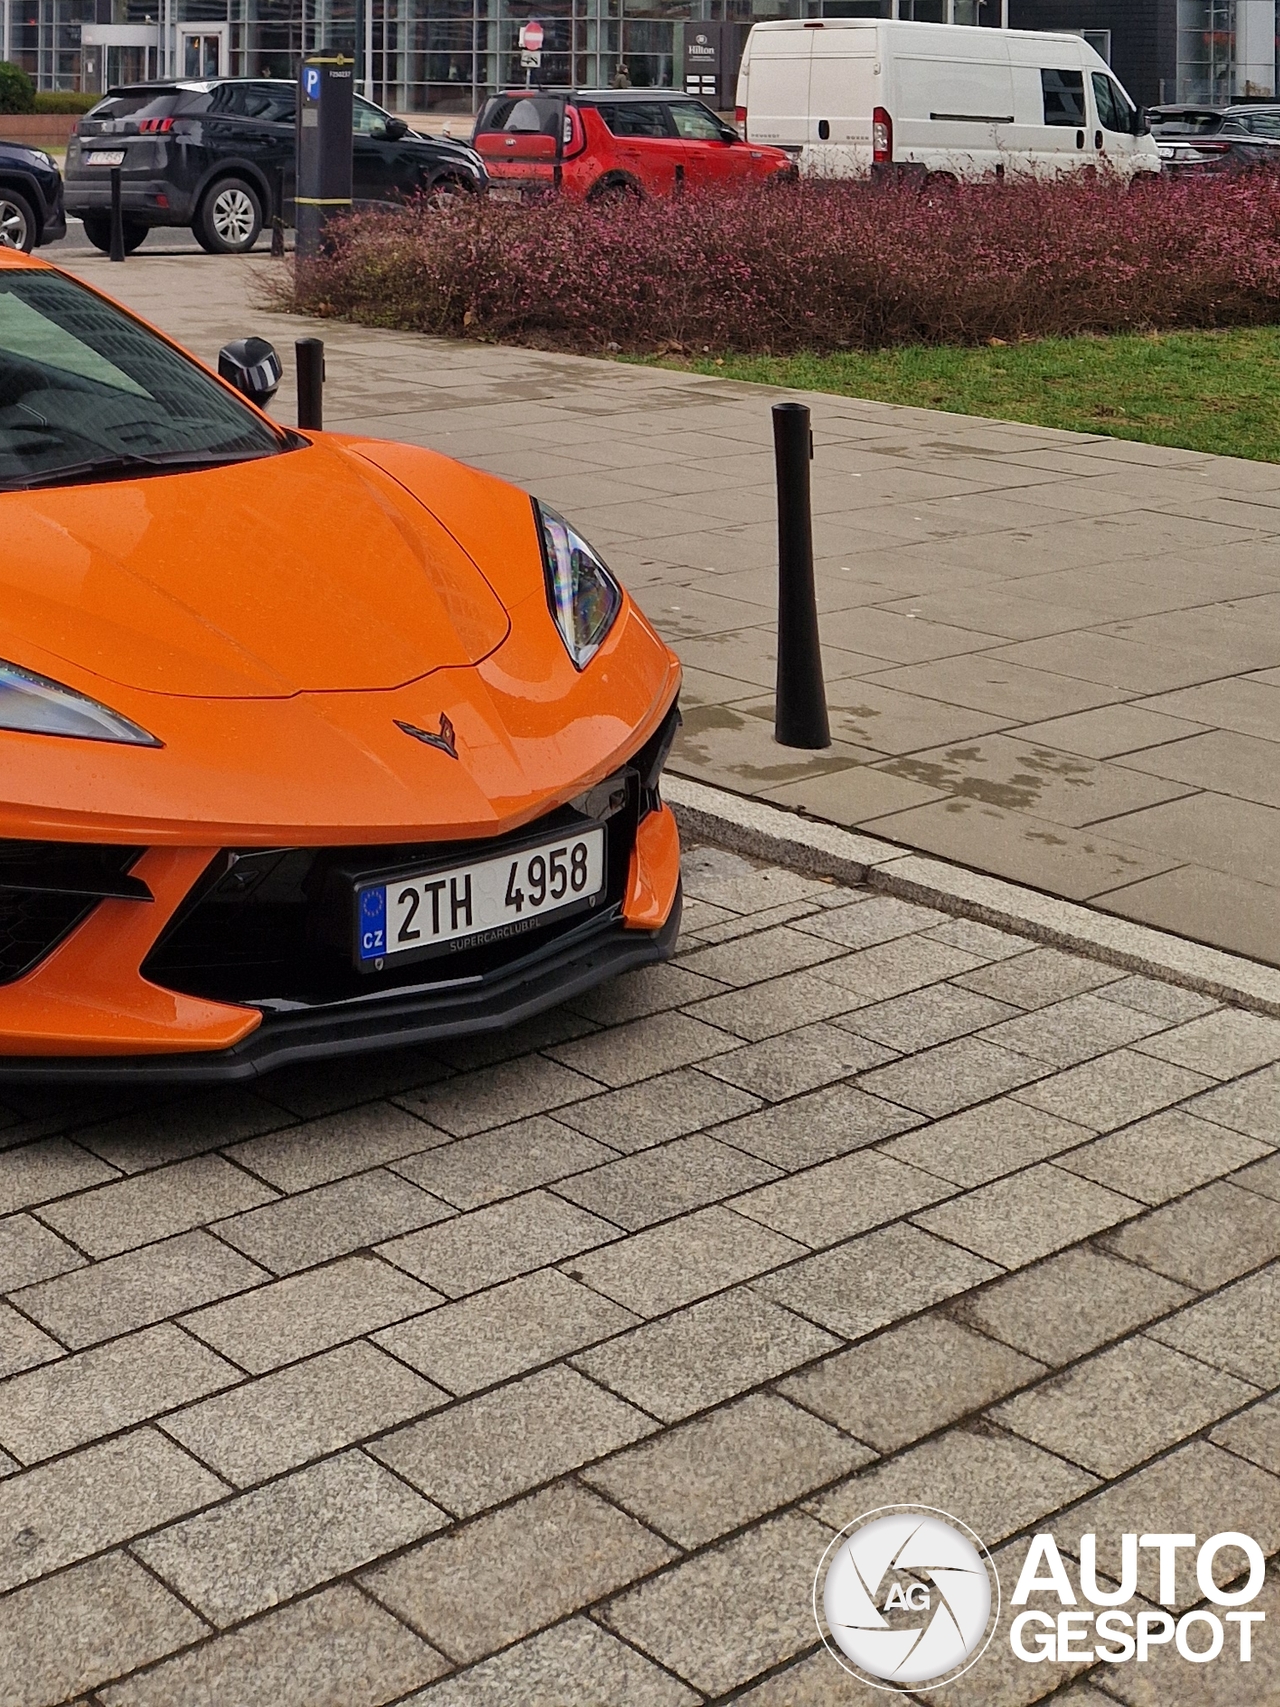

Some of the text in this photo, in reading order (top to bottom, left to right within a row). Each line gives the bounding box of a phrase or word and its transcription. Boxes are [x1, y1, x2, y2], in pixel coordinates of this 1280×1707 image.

[688, 45, 715, 54] Hilton
[307, 70, 318, 93] P
[397, 842, 588, 943] 2TH 4958
[363, 929, 383, 949] CZ
[449, 918, 541, 952] SUPERCARCLUB.PL
